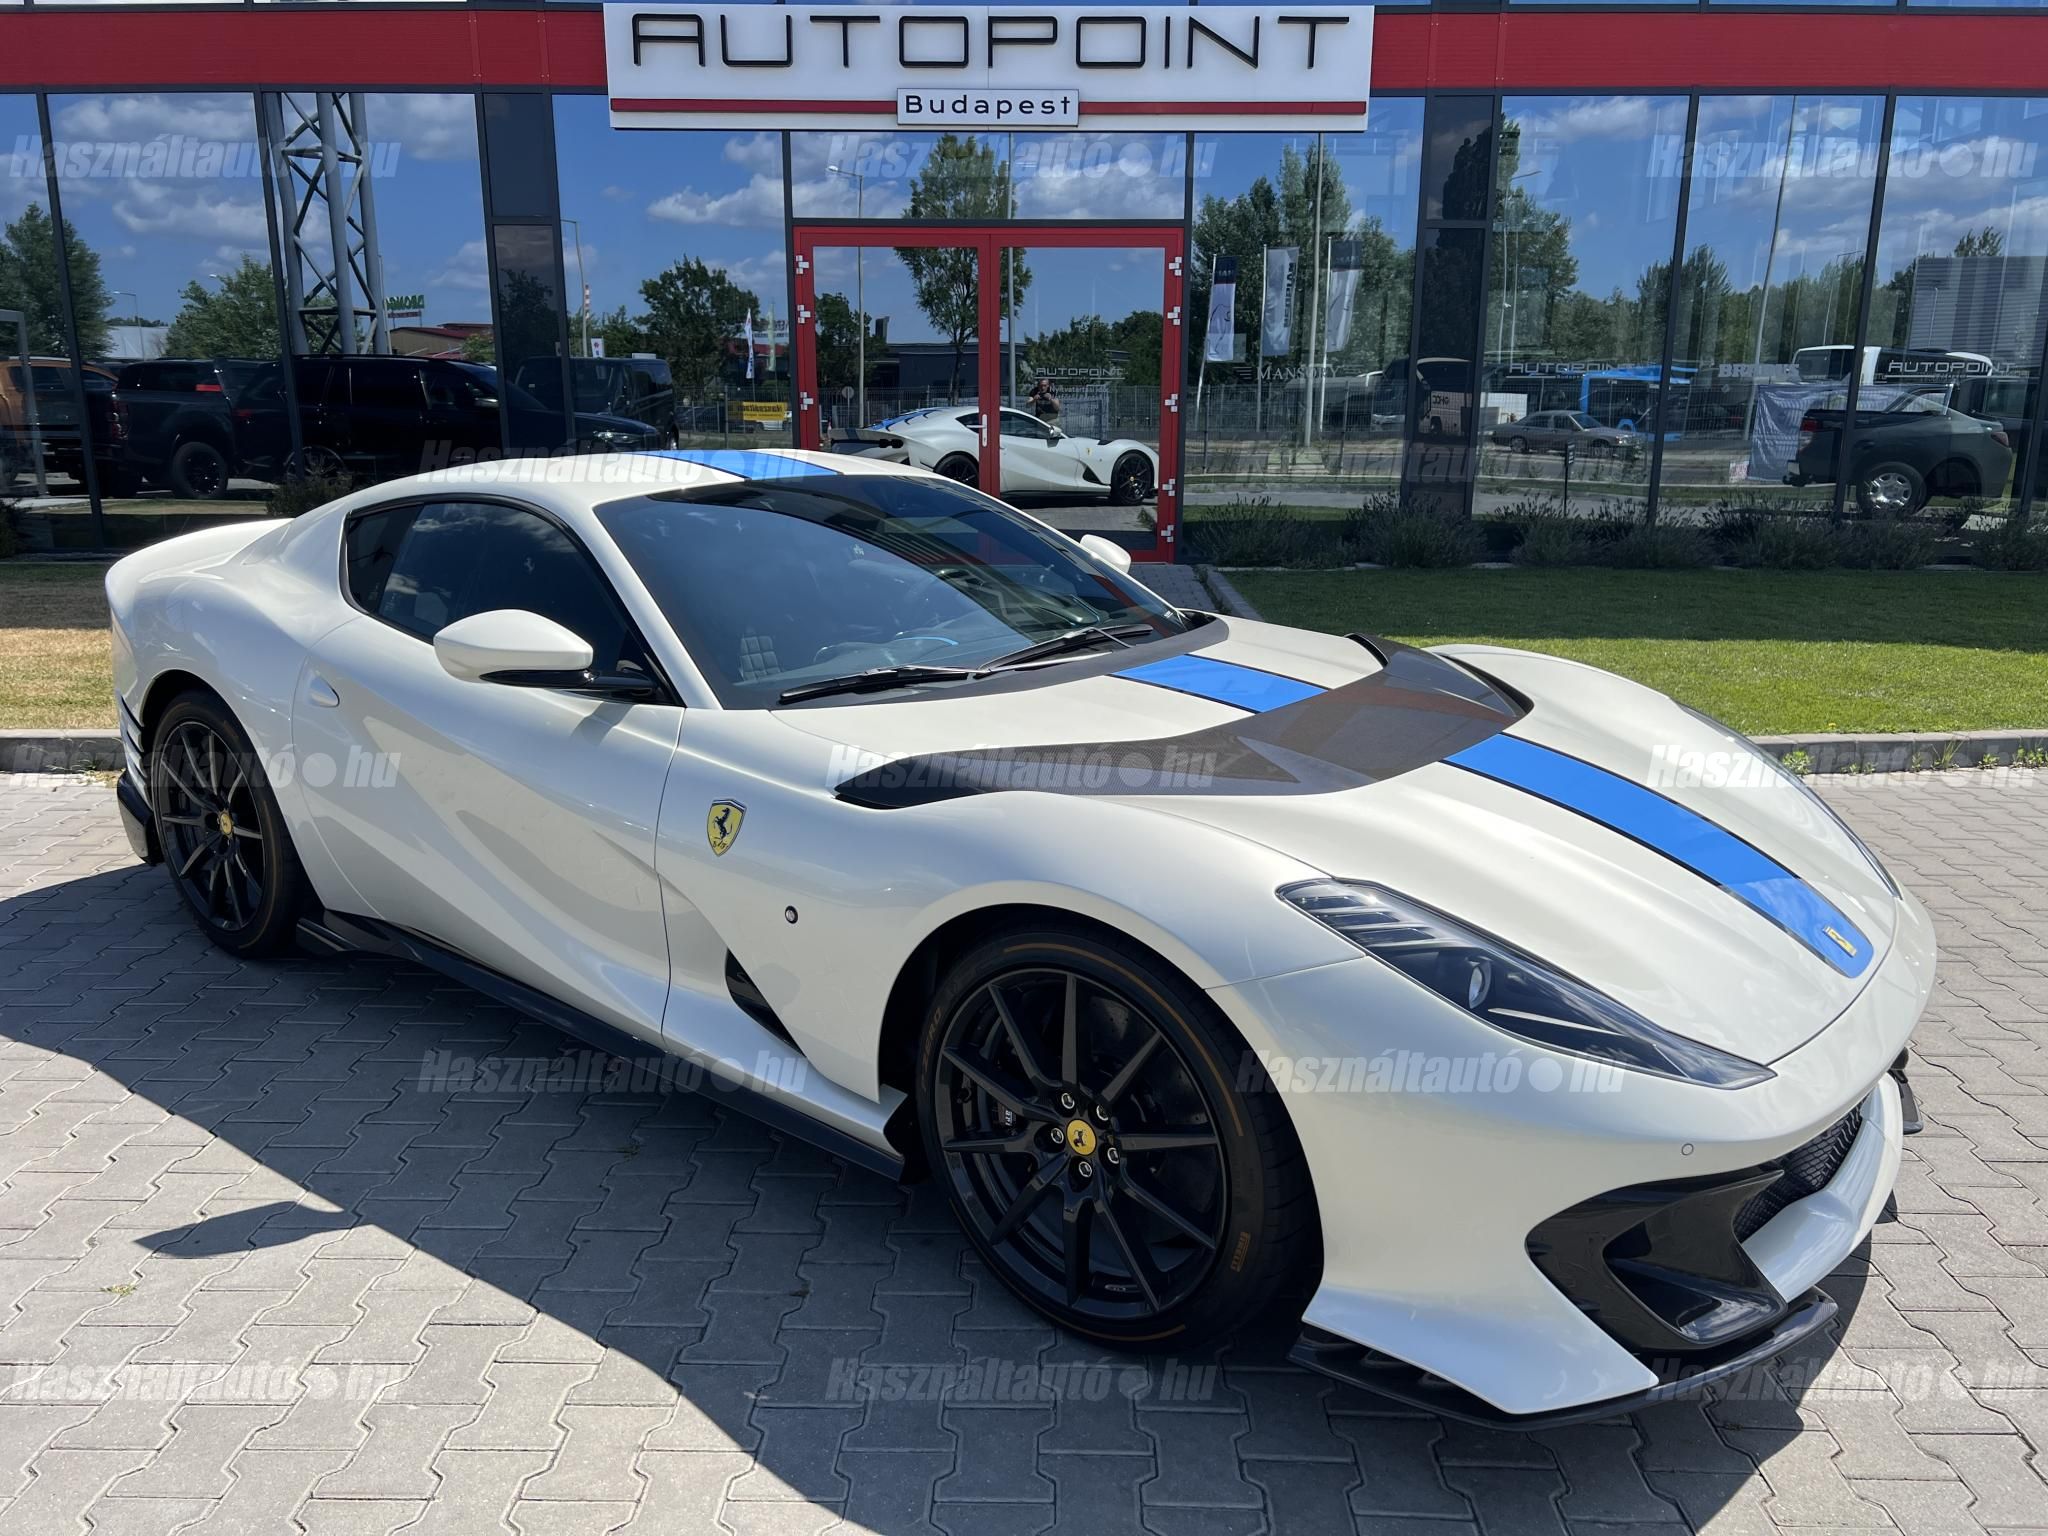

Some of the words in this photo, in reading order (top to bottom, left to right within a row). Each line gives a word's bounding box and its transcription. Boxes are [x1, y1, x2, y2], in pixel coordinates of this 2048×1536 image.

[632, 13, 1349, 69] AUTOPOINT
[905, 93, 1072, 119] Budapest
[1036, 367, 1124, 377] AUTOPOINT
[1887, 361, 2016, 373] AUTOPOINT
